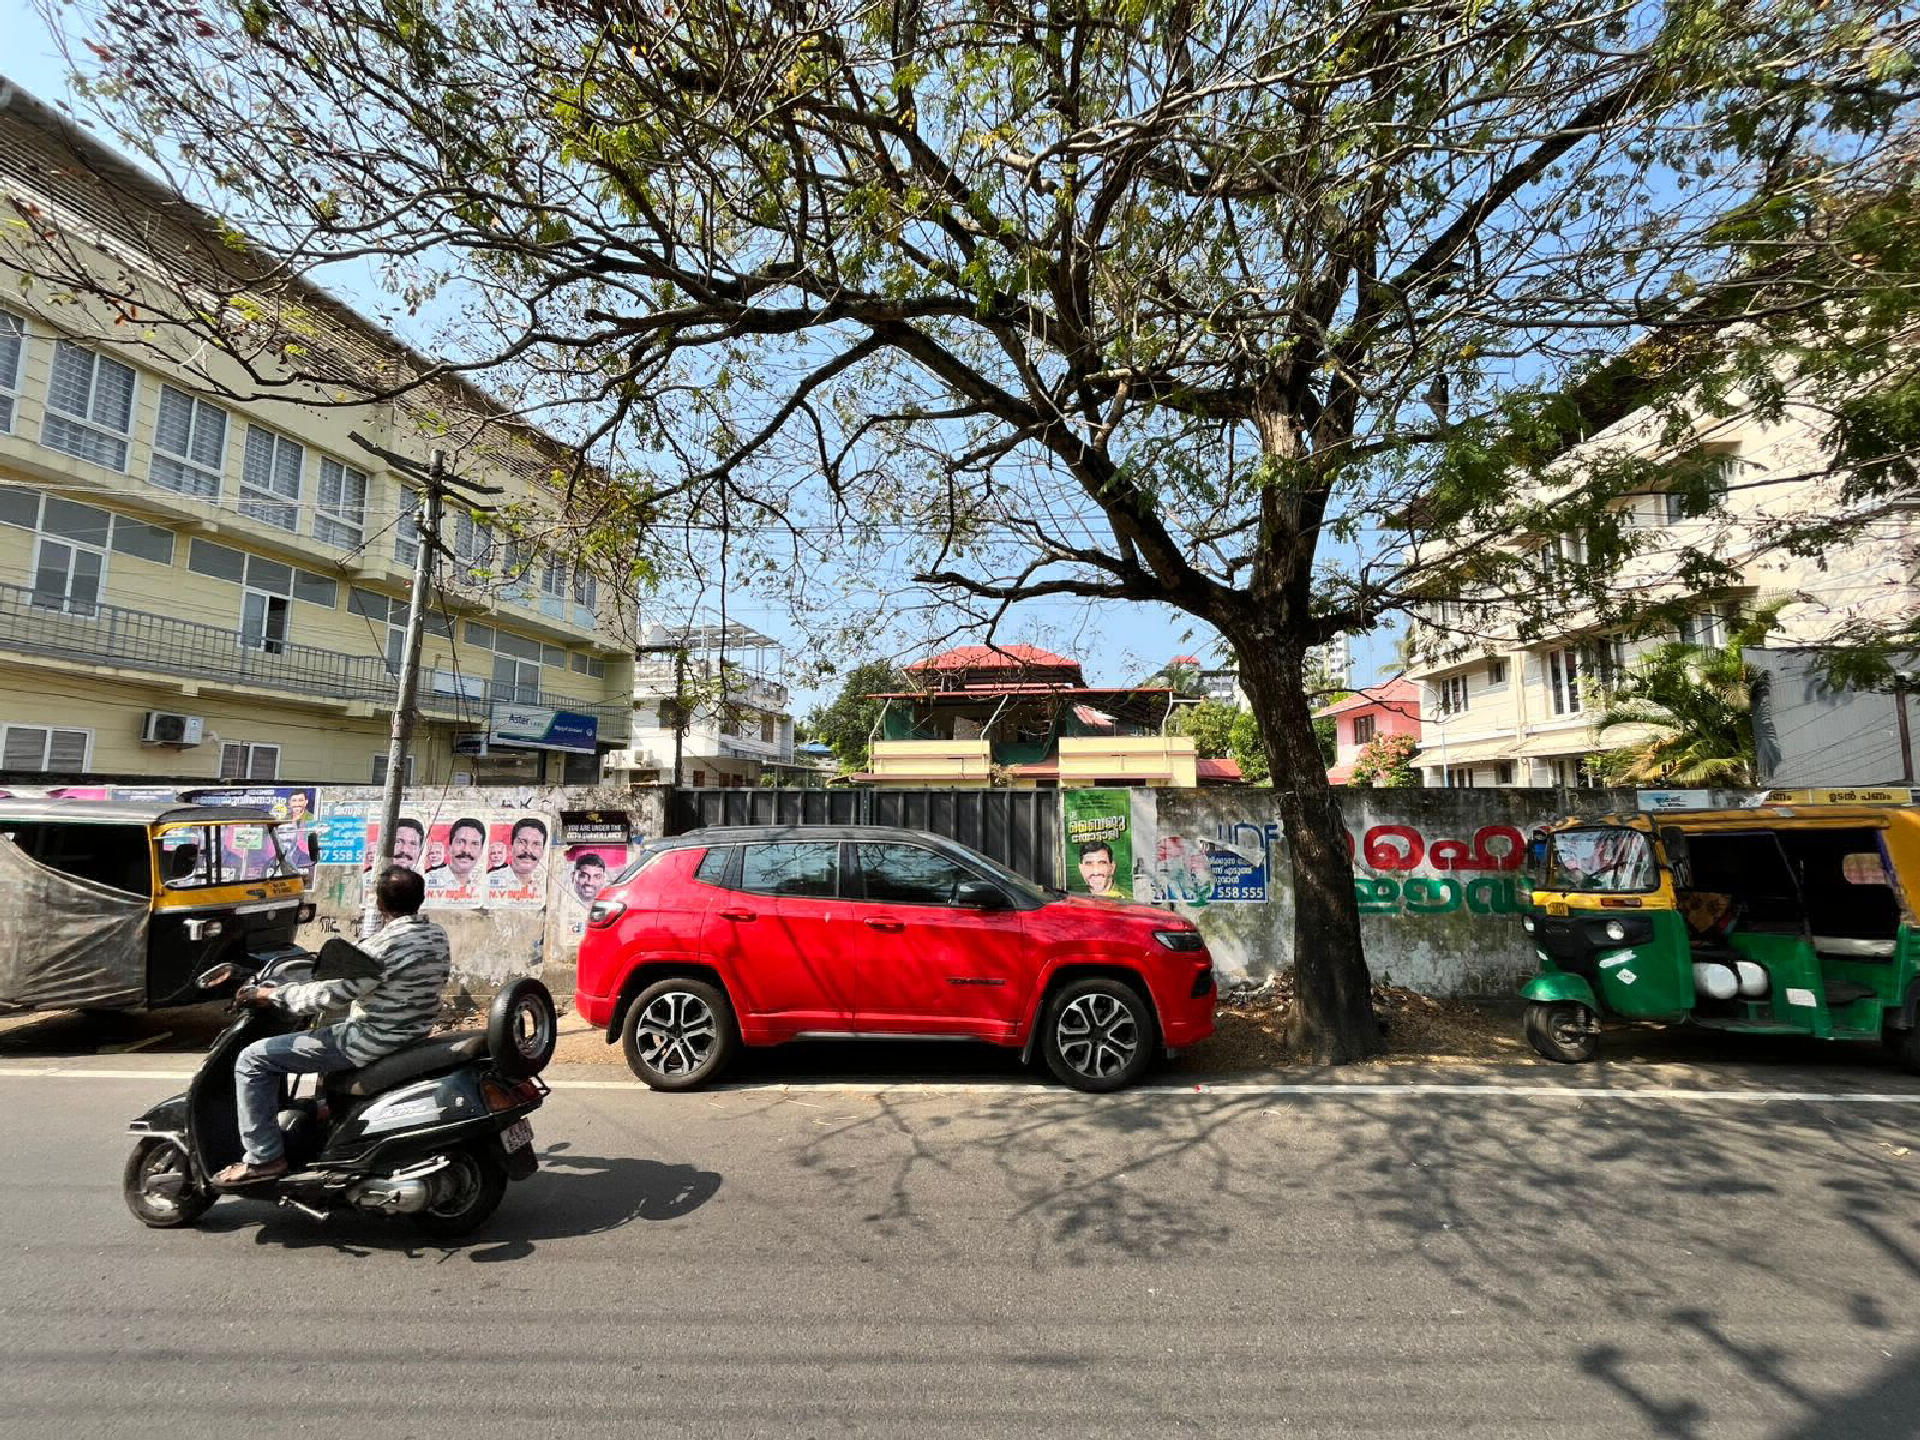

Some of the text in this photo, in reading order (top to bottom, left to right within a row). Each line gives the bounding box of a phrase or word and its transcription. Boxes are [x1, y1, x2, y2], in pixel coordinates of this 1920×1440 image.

[508, 713, 530, 725] Aster
[332, 850, 352, 861] 558
[1218, 887, 1239, 898] 558
[1242, 887, 1263, 898] 555
